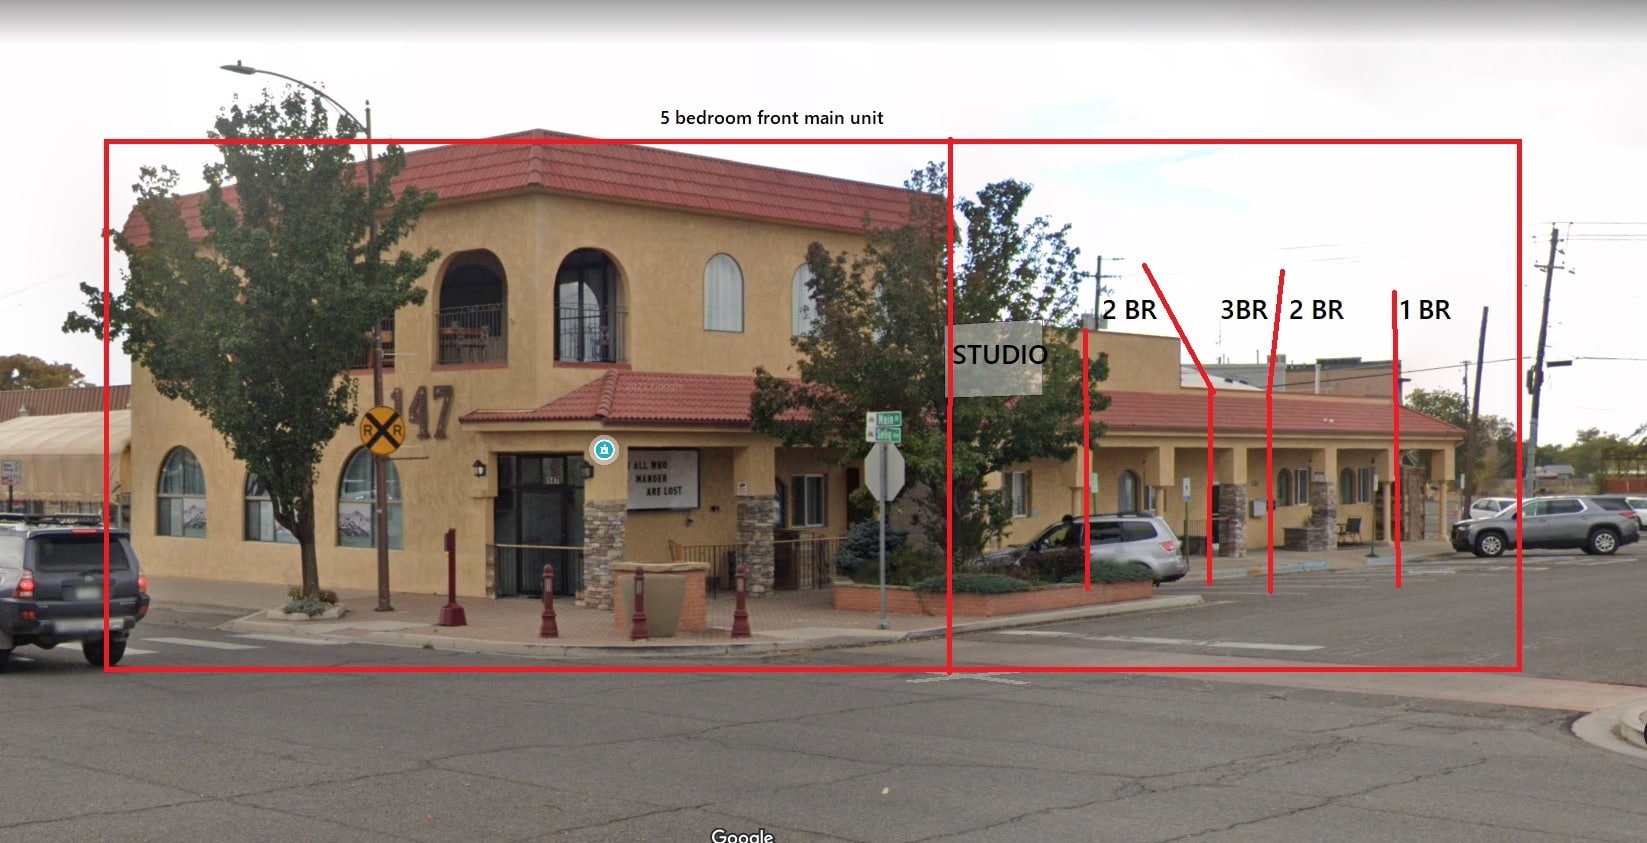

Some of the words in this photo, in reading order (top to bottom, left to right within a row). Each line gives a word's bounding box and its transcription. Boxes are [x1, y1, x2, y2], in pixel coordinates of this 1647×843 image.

[391, 385, 454, 440] 147
[878, 413, 894, 425] Main
[363, 425, 373, 436] R
[393, 425, 402, 436] R
[633, 461, 648, 470] ALL
[651, 460, 668, 470] WHO
[646, 487, 662, 496] ARE
[664, 486, 682, 496] LOST
